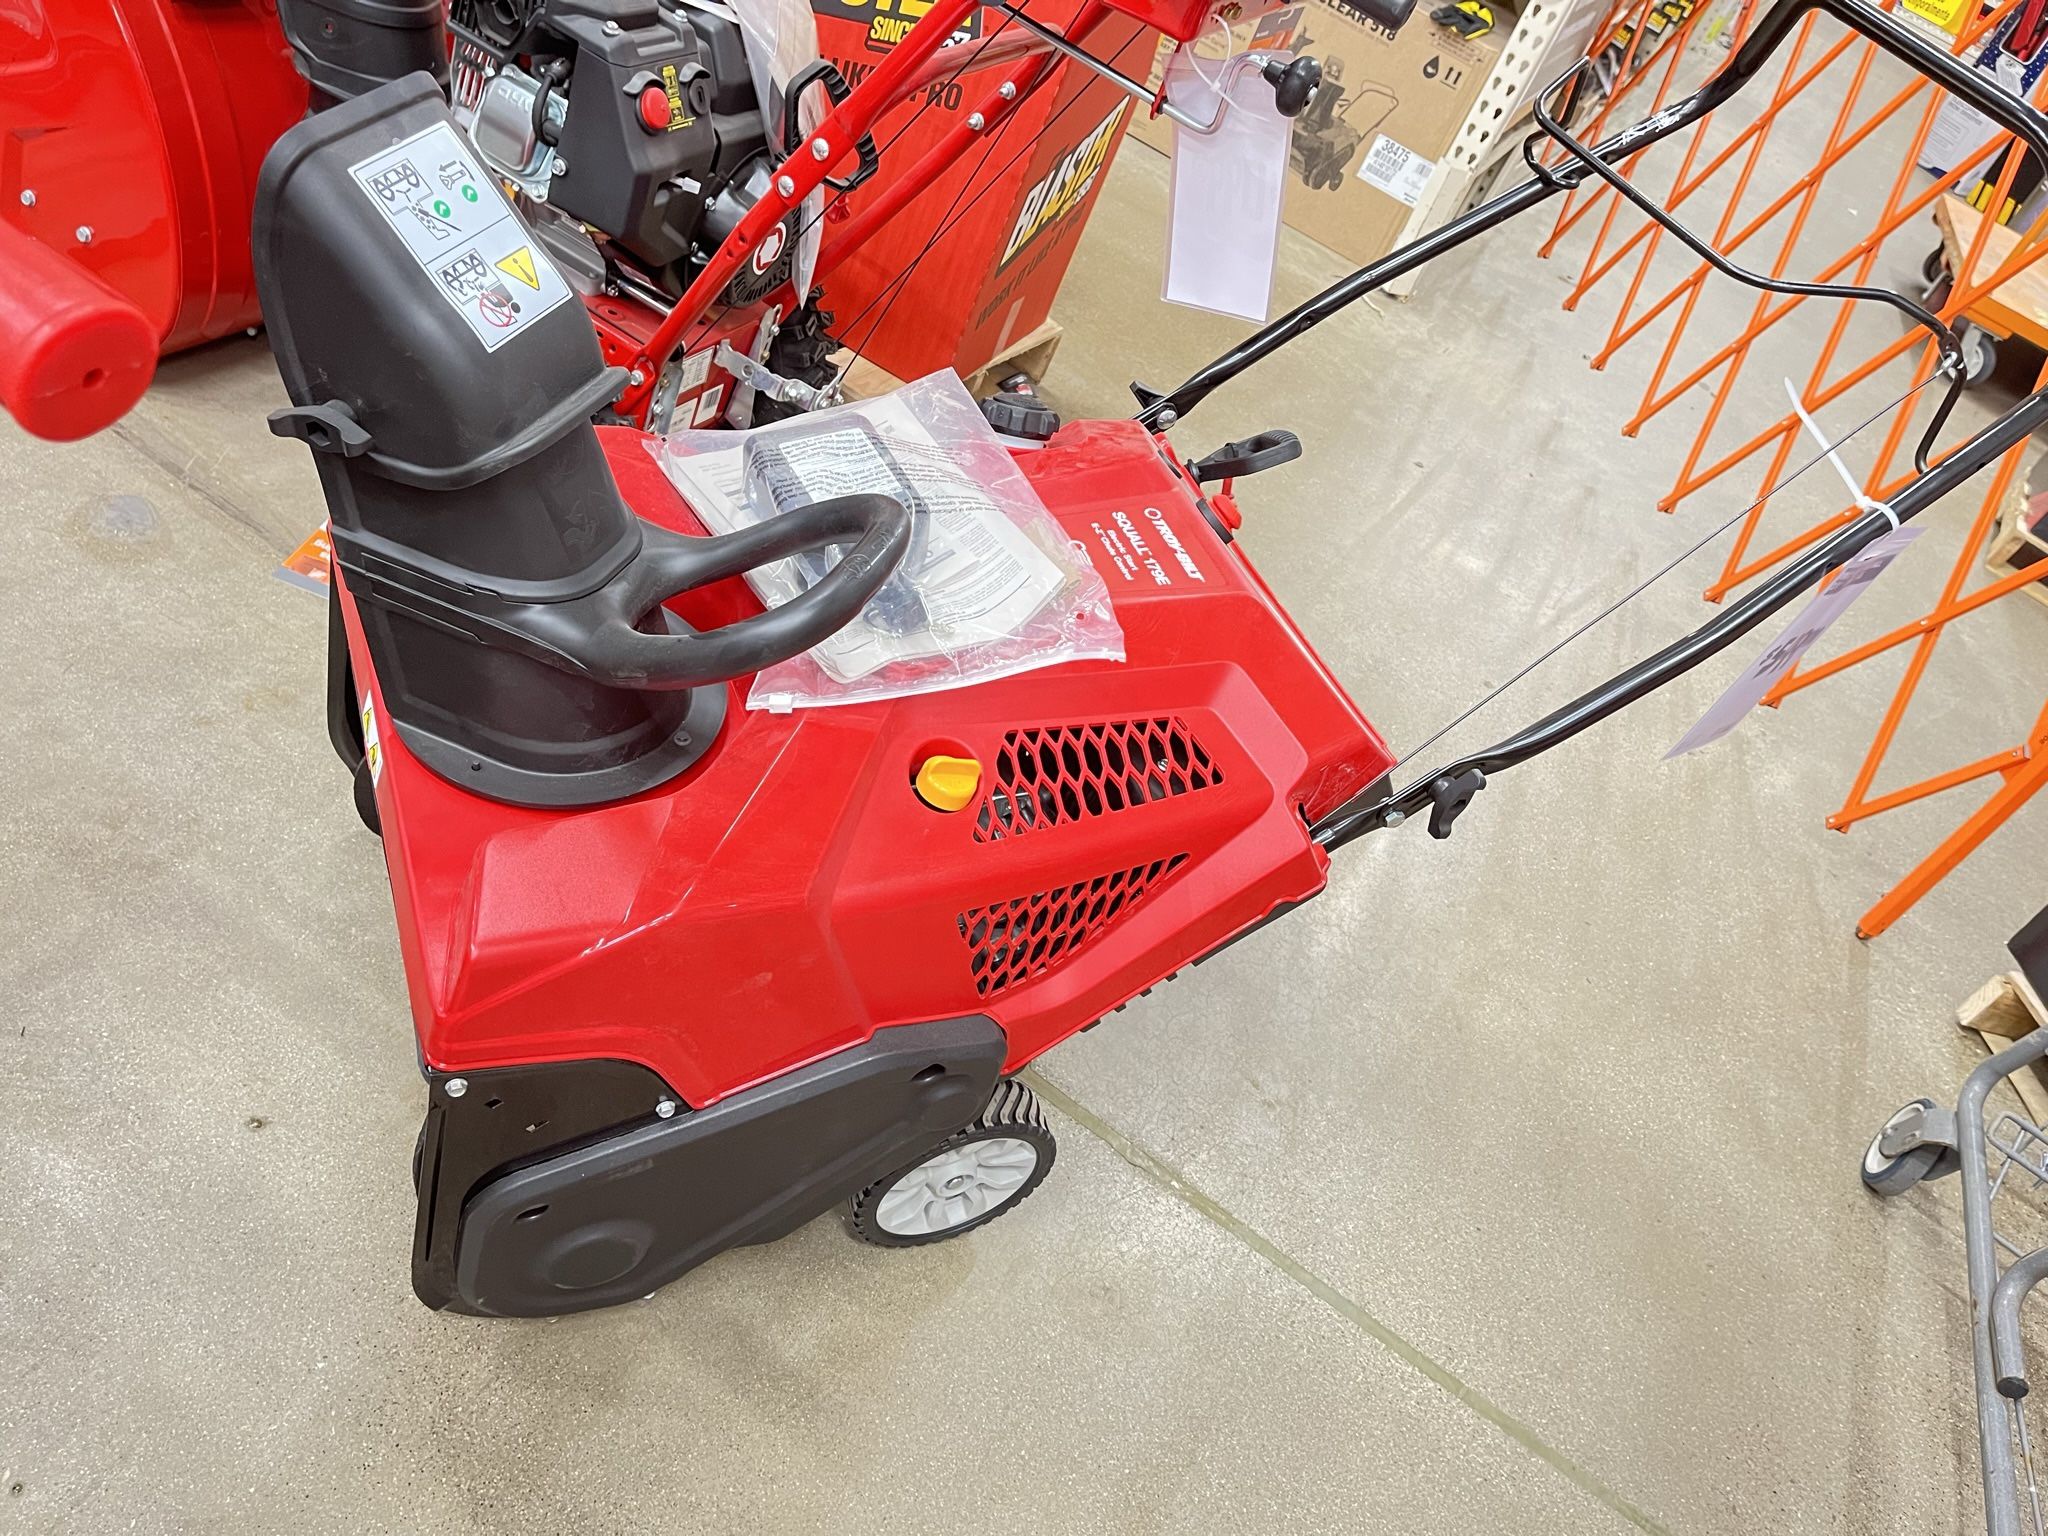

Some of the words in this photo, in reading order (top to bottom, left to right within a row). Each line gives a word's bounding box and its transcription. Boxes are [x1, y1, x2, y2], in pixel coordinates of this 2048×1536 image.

[869, 16, 916, 43] SINC
[1381, 139, 1411, 163] 38475
[1000, 94, 1130, 267] BLASTER
[1113, 556, 1134, 581] Control
[1122, 553, 1139, 572] Start
[1143, 557, 1171, 586] 179E
